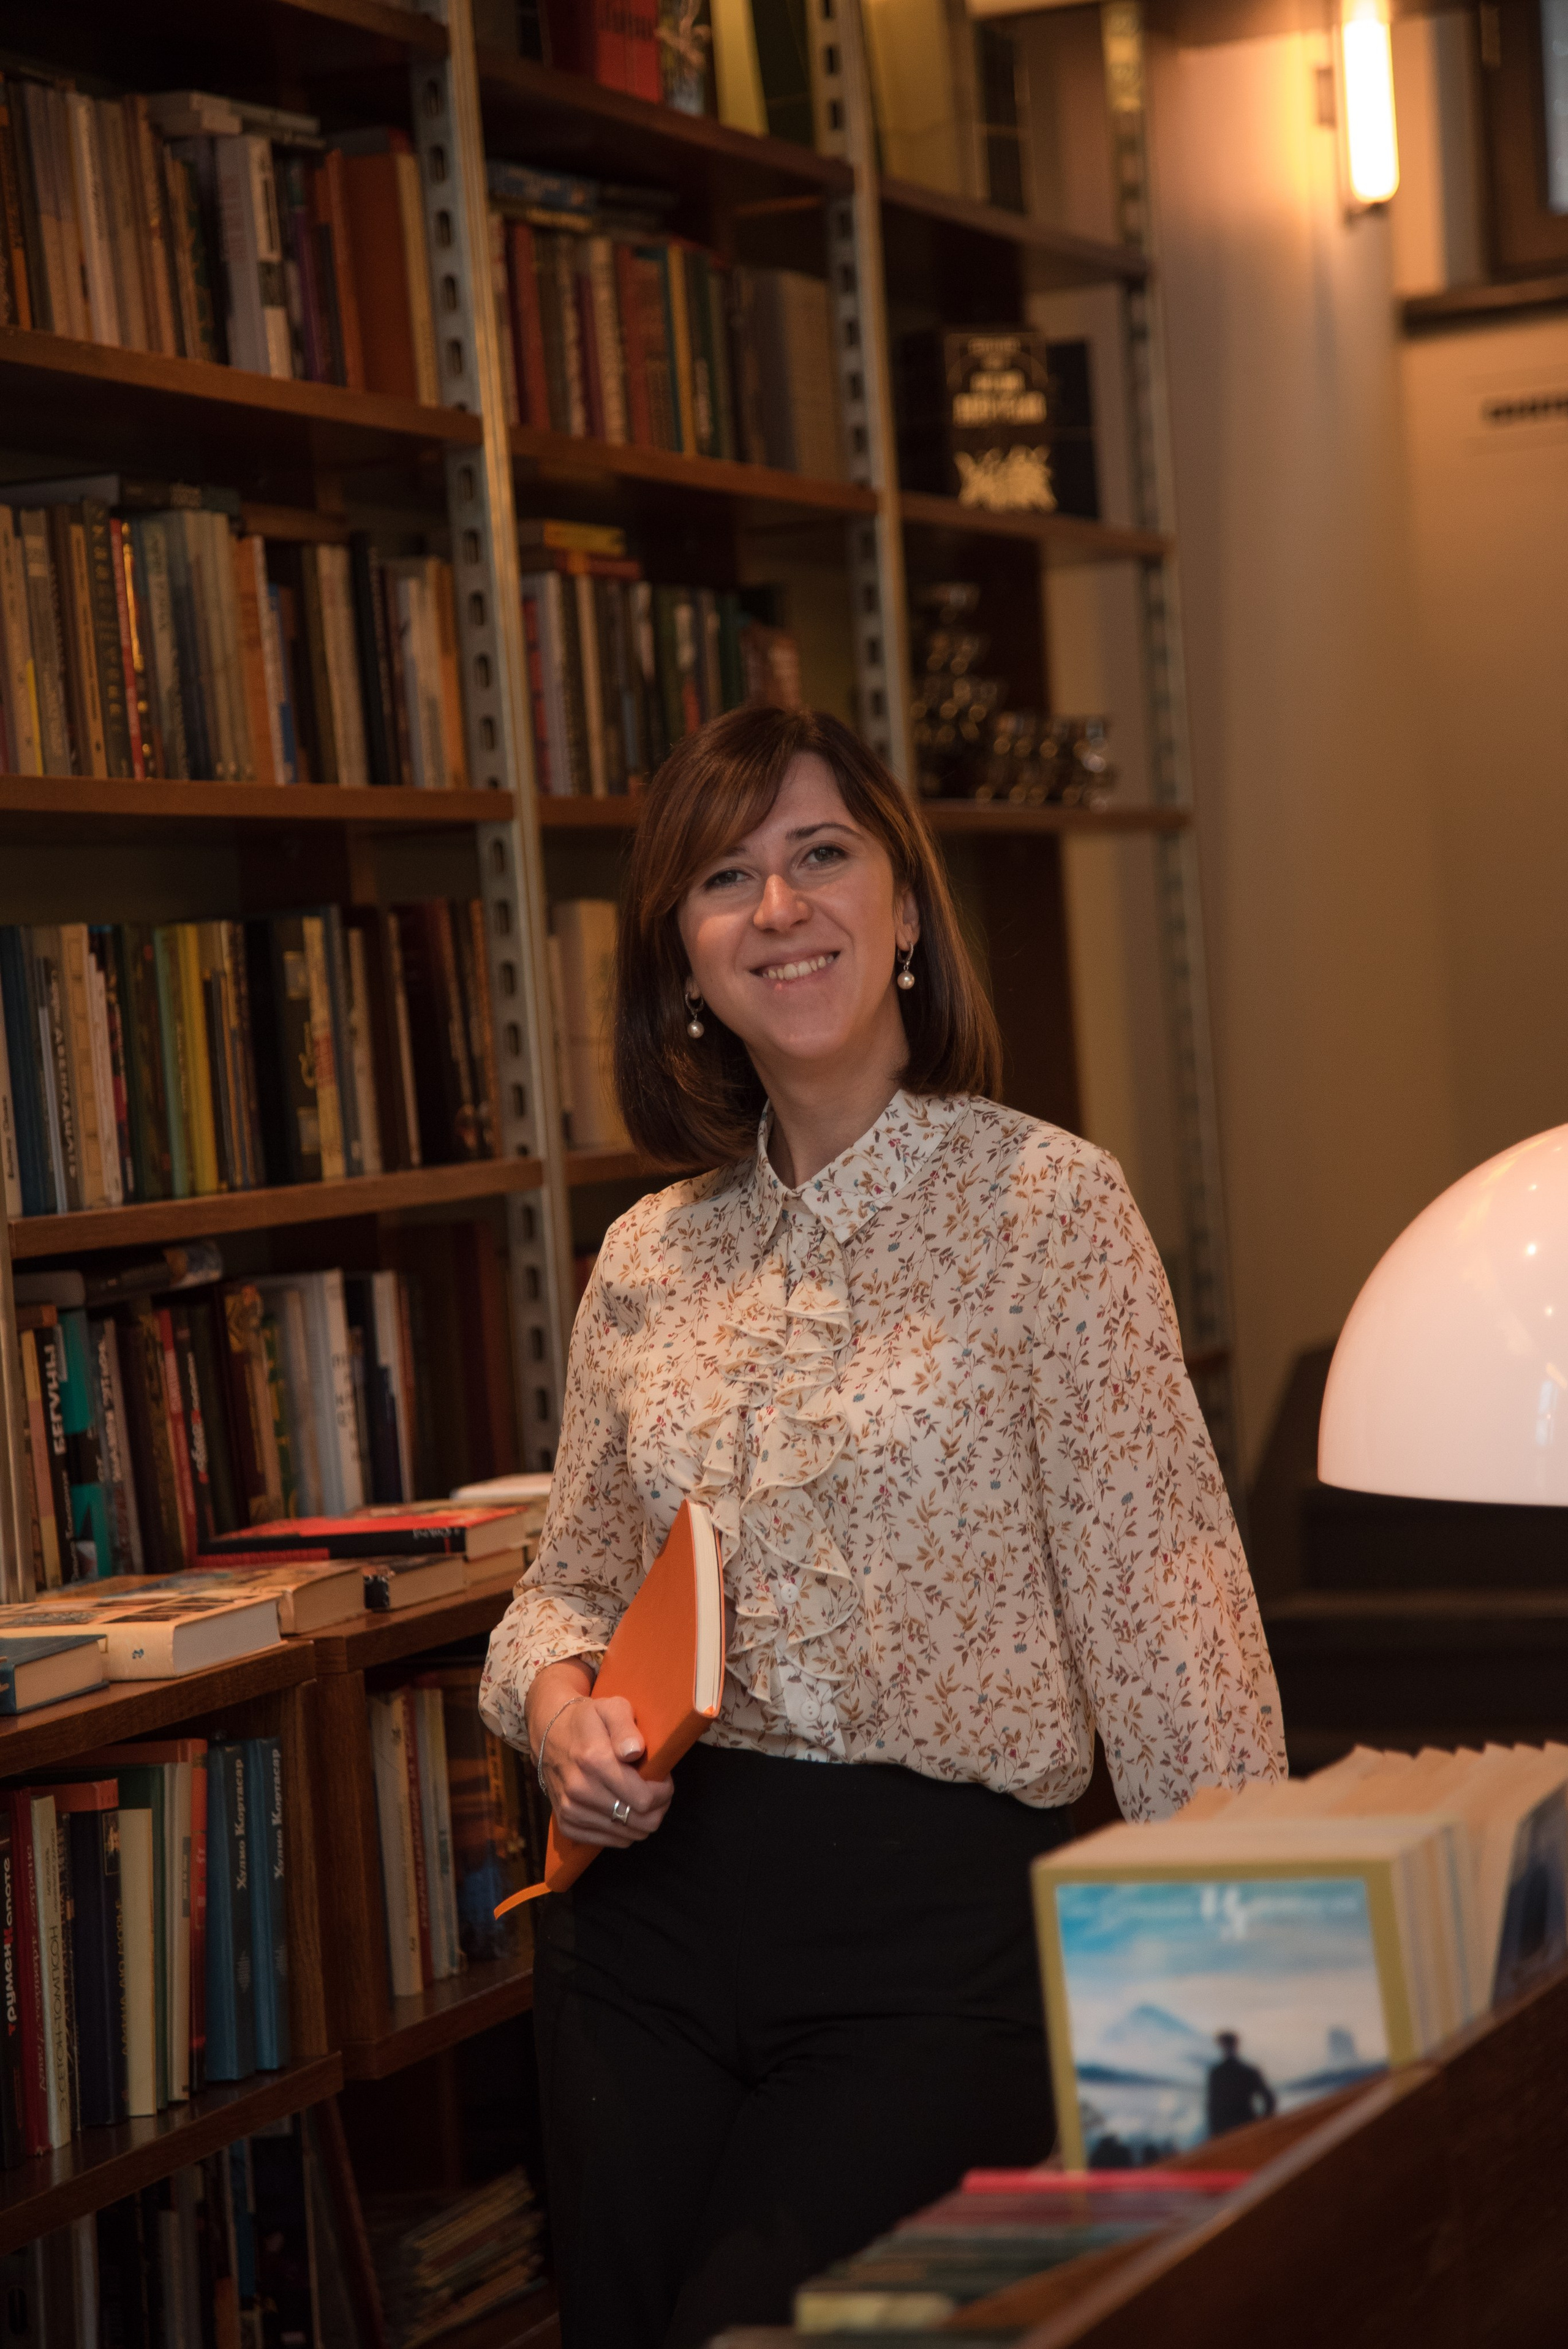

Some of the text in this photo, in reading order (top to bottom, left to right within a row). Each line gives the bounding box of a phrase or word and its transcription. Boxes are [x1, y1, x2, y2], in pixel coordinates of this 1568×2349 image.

[43, 1343, 67, 1455] БЕГУНЫ
[233, 1759, 247, 1890] Хулио Кортасар
[271, 1748, 284, 1880] Хулио Кортасар
